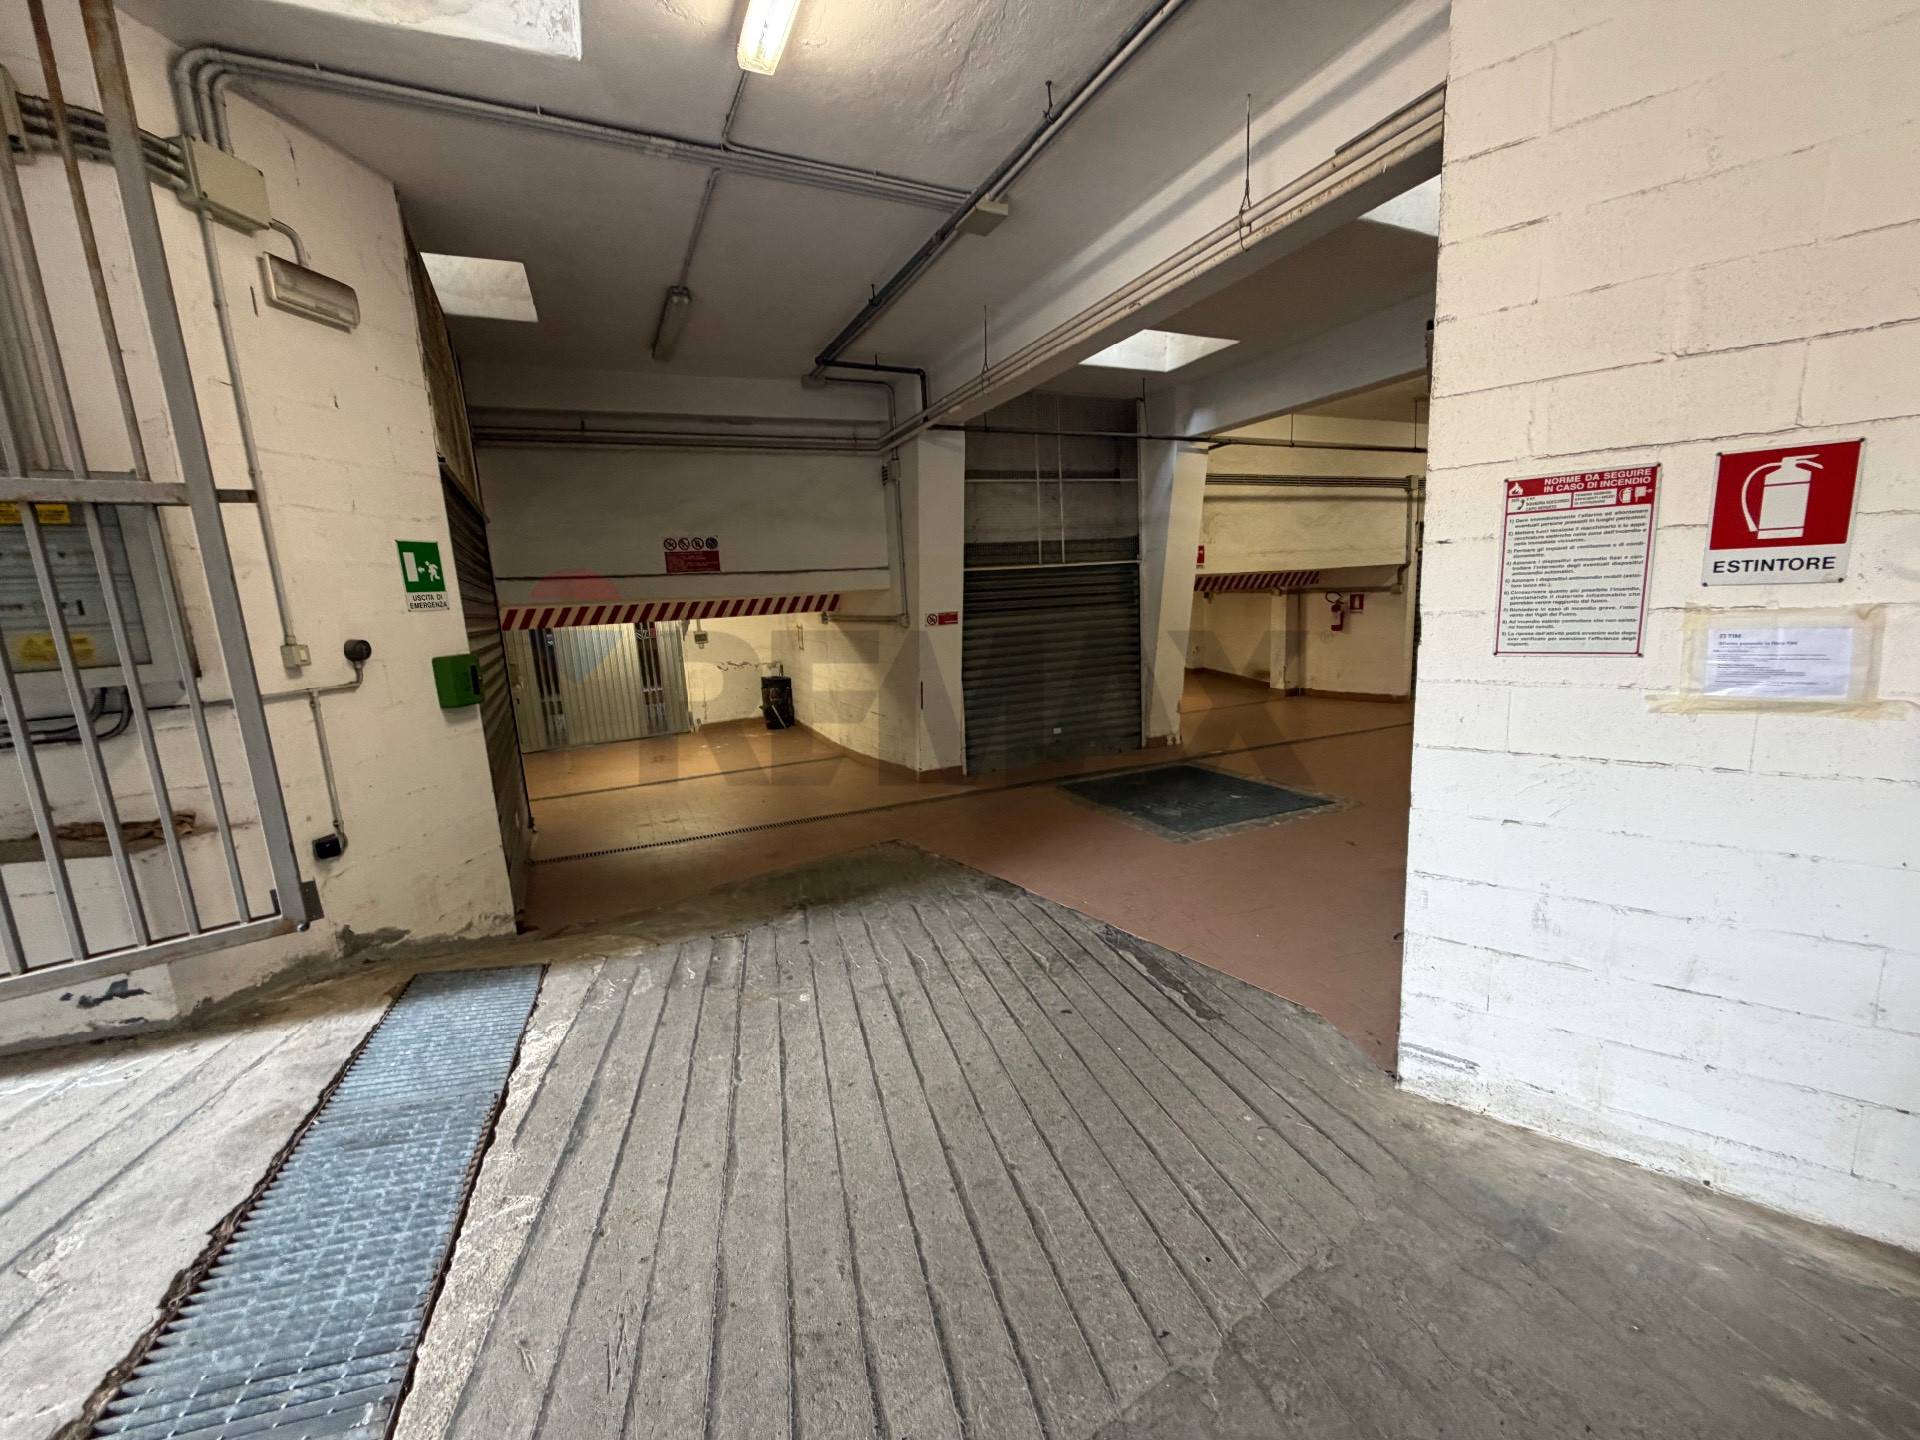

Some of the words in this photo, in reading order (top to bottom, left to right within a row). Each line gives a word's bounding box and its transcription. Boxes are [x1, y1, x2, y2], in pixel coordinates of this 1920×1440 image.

[1544, 475, 1581, 485] NORME
[1585, 473, 1600, 481] DA
[1603, 468, 1652, 480] SEGUIRE
[1544, 485, 1554, 493] IN
[1556, 483, 1584, 492] CASO
[1587, 481, 1597, 489] DI
[1600, 476, 1652, 488] INCENDIO
[1713, 556, 1836, 574] ESTINTORE
[410, 601, 447, 609] EMERGENZA
